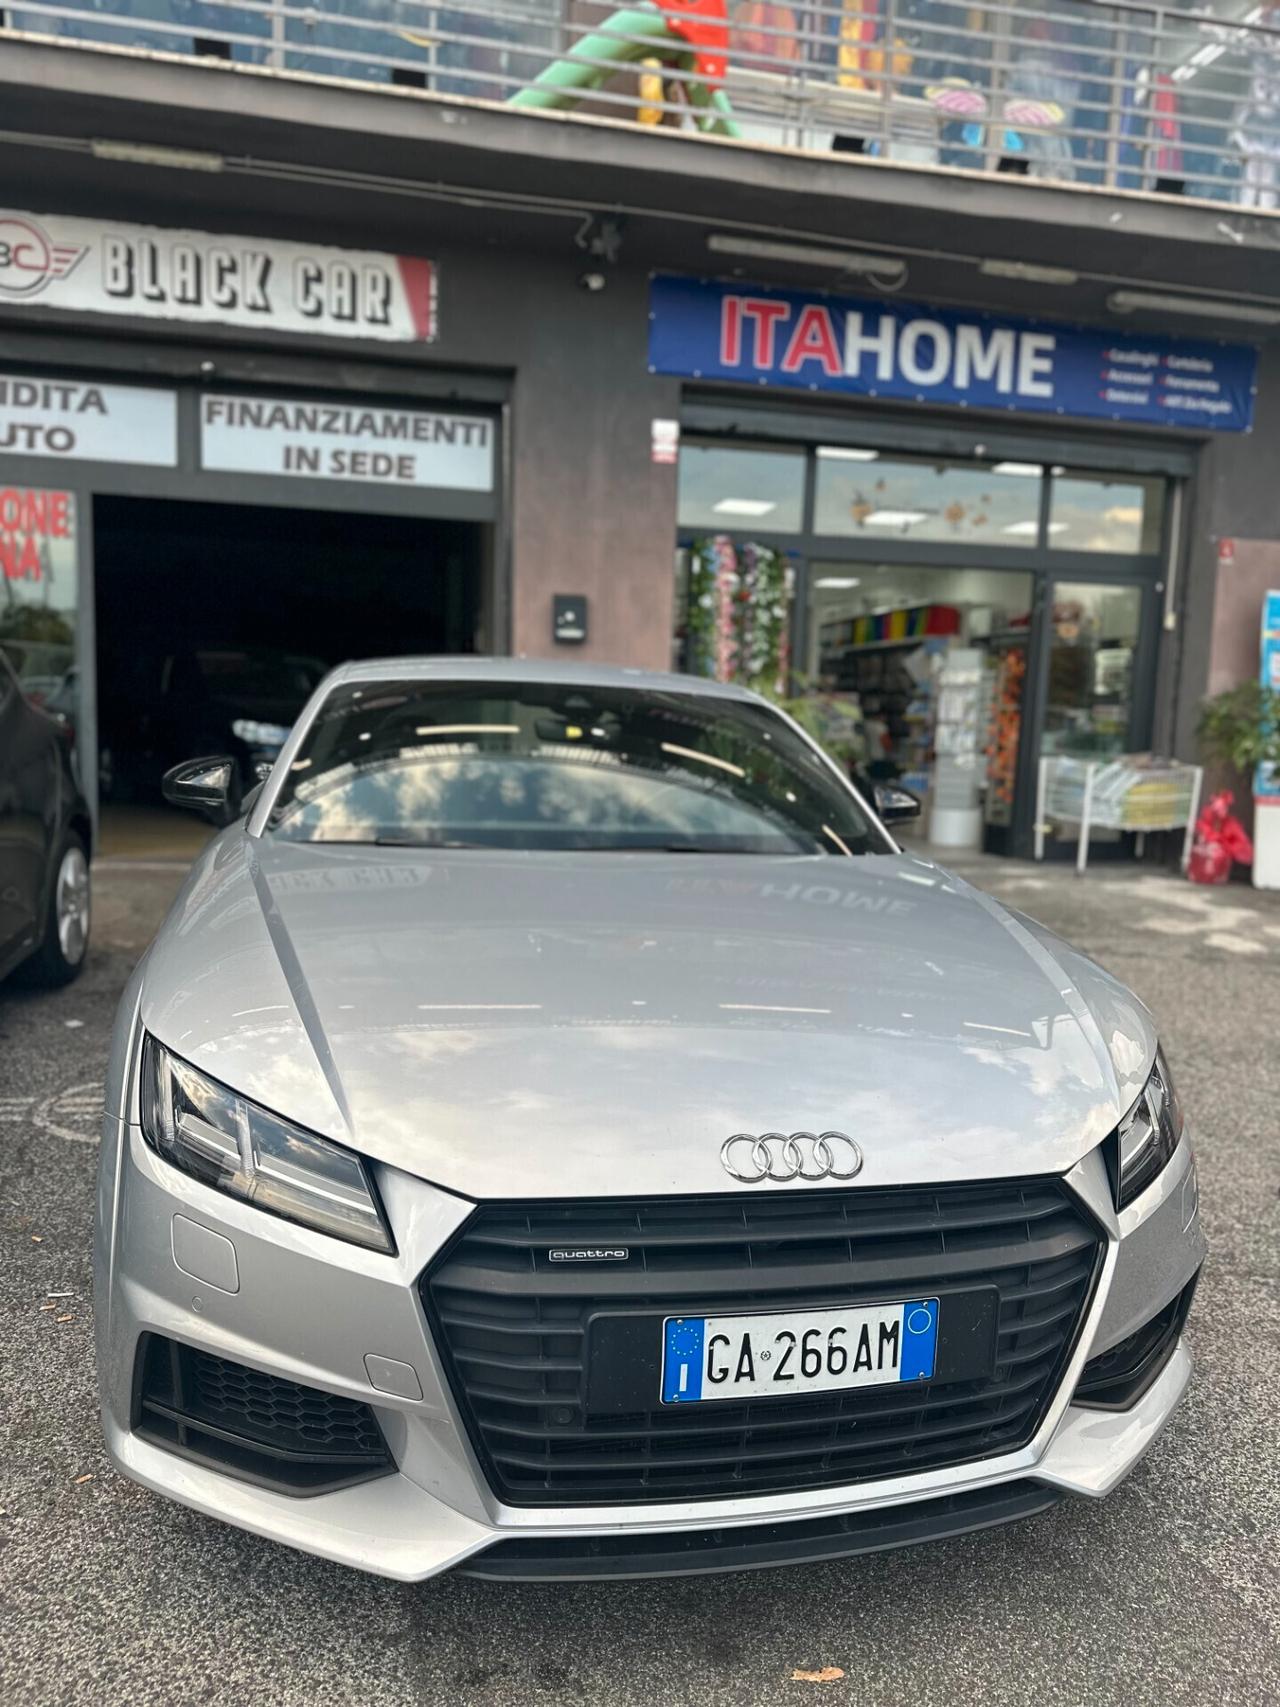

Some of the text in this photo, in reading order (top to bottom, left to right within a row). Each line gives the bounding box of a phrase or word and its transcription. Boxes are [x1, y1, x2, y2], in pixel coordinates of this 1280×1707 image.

[104, 233, 394, 326] BLACK CAR
[720, 294, 1057, 399] ITAHOME
[206, 400, 488, 448] FINANZIAMENTI
[283, 445, 417, 481] IN SEDE
[552, 1249, 625, 1261] quattro
[707, 1319, 901, 1384] GA 266AM
